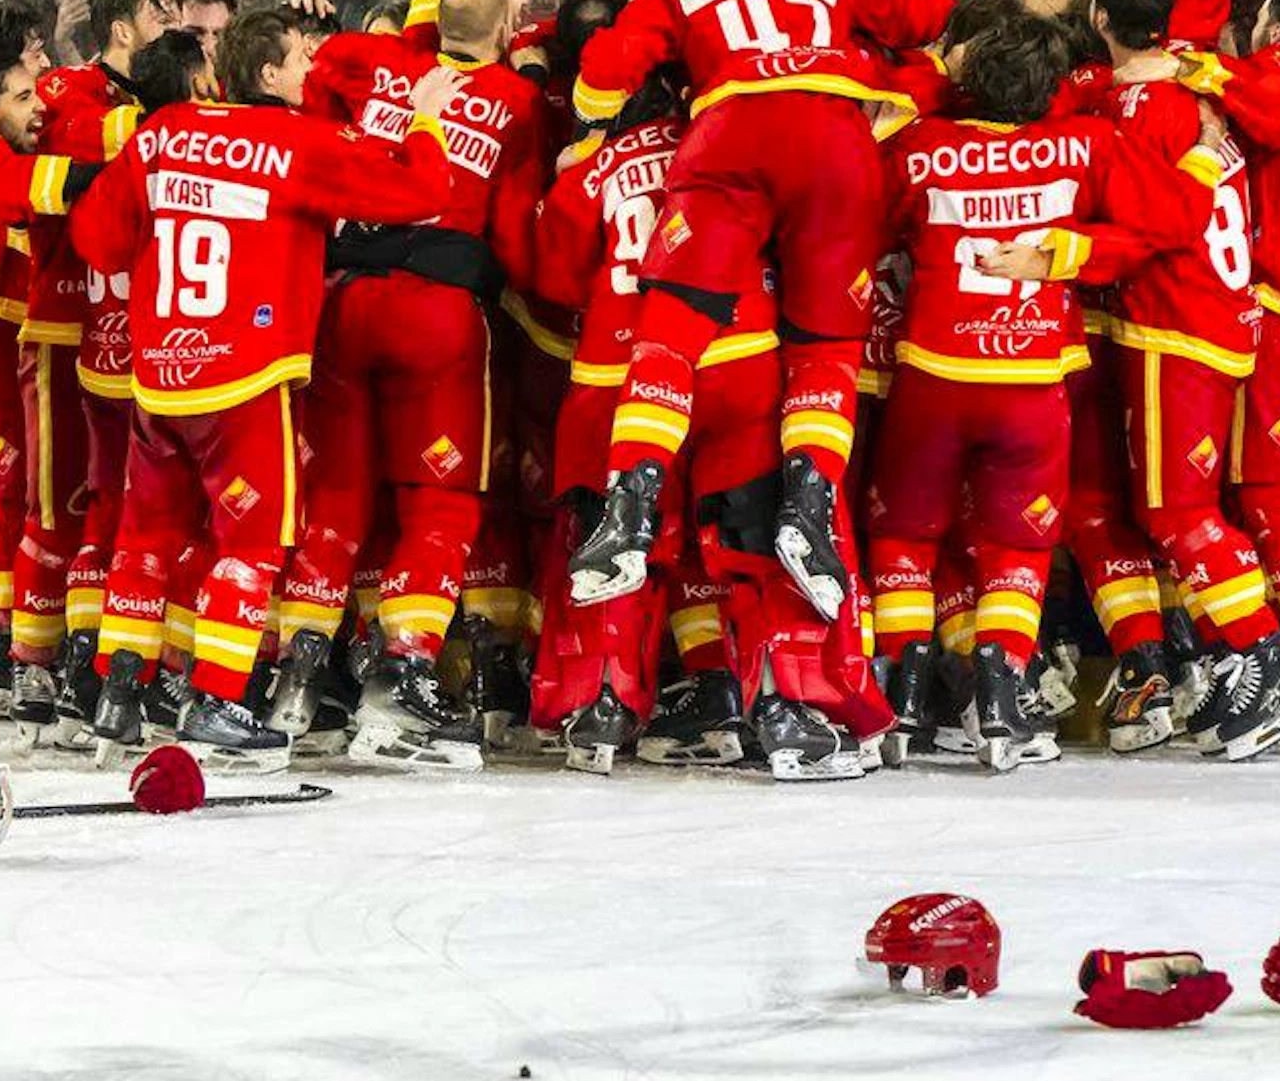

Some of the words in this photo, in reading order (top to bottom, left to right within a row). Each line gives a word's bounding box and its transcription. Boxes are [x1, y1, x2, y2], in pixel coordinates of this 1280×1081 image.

[372, 66, 513, 130] DOCOIN
[583, 124, 682, 200] DOGEC
[617, 156, 675, 198] FATT
[164, 176, 215, 208] KAST
[963, 192, 1043, 223] PRIVET
[154, 218, 231, 319] 19
[908, 895, 972, 933] SCHIRINZ
